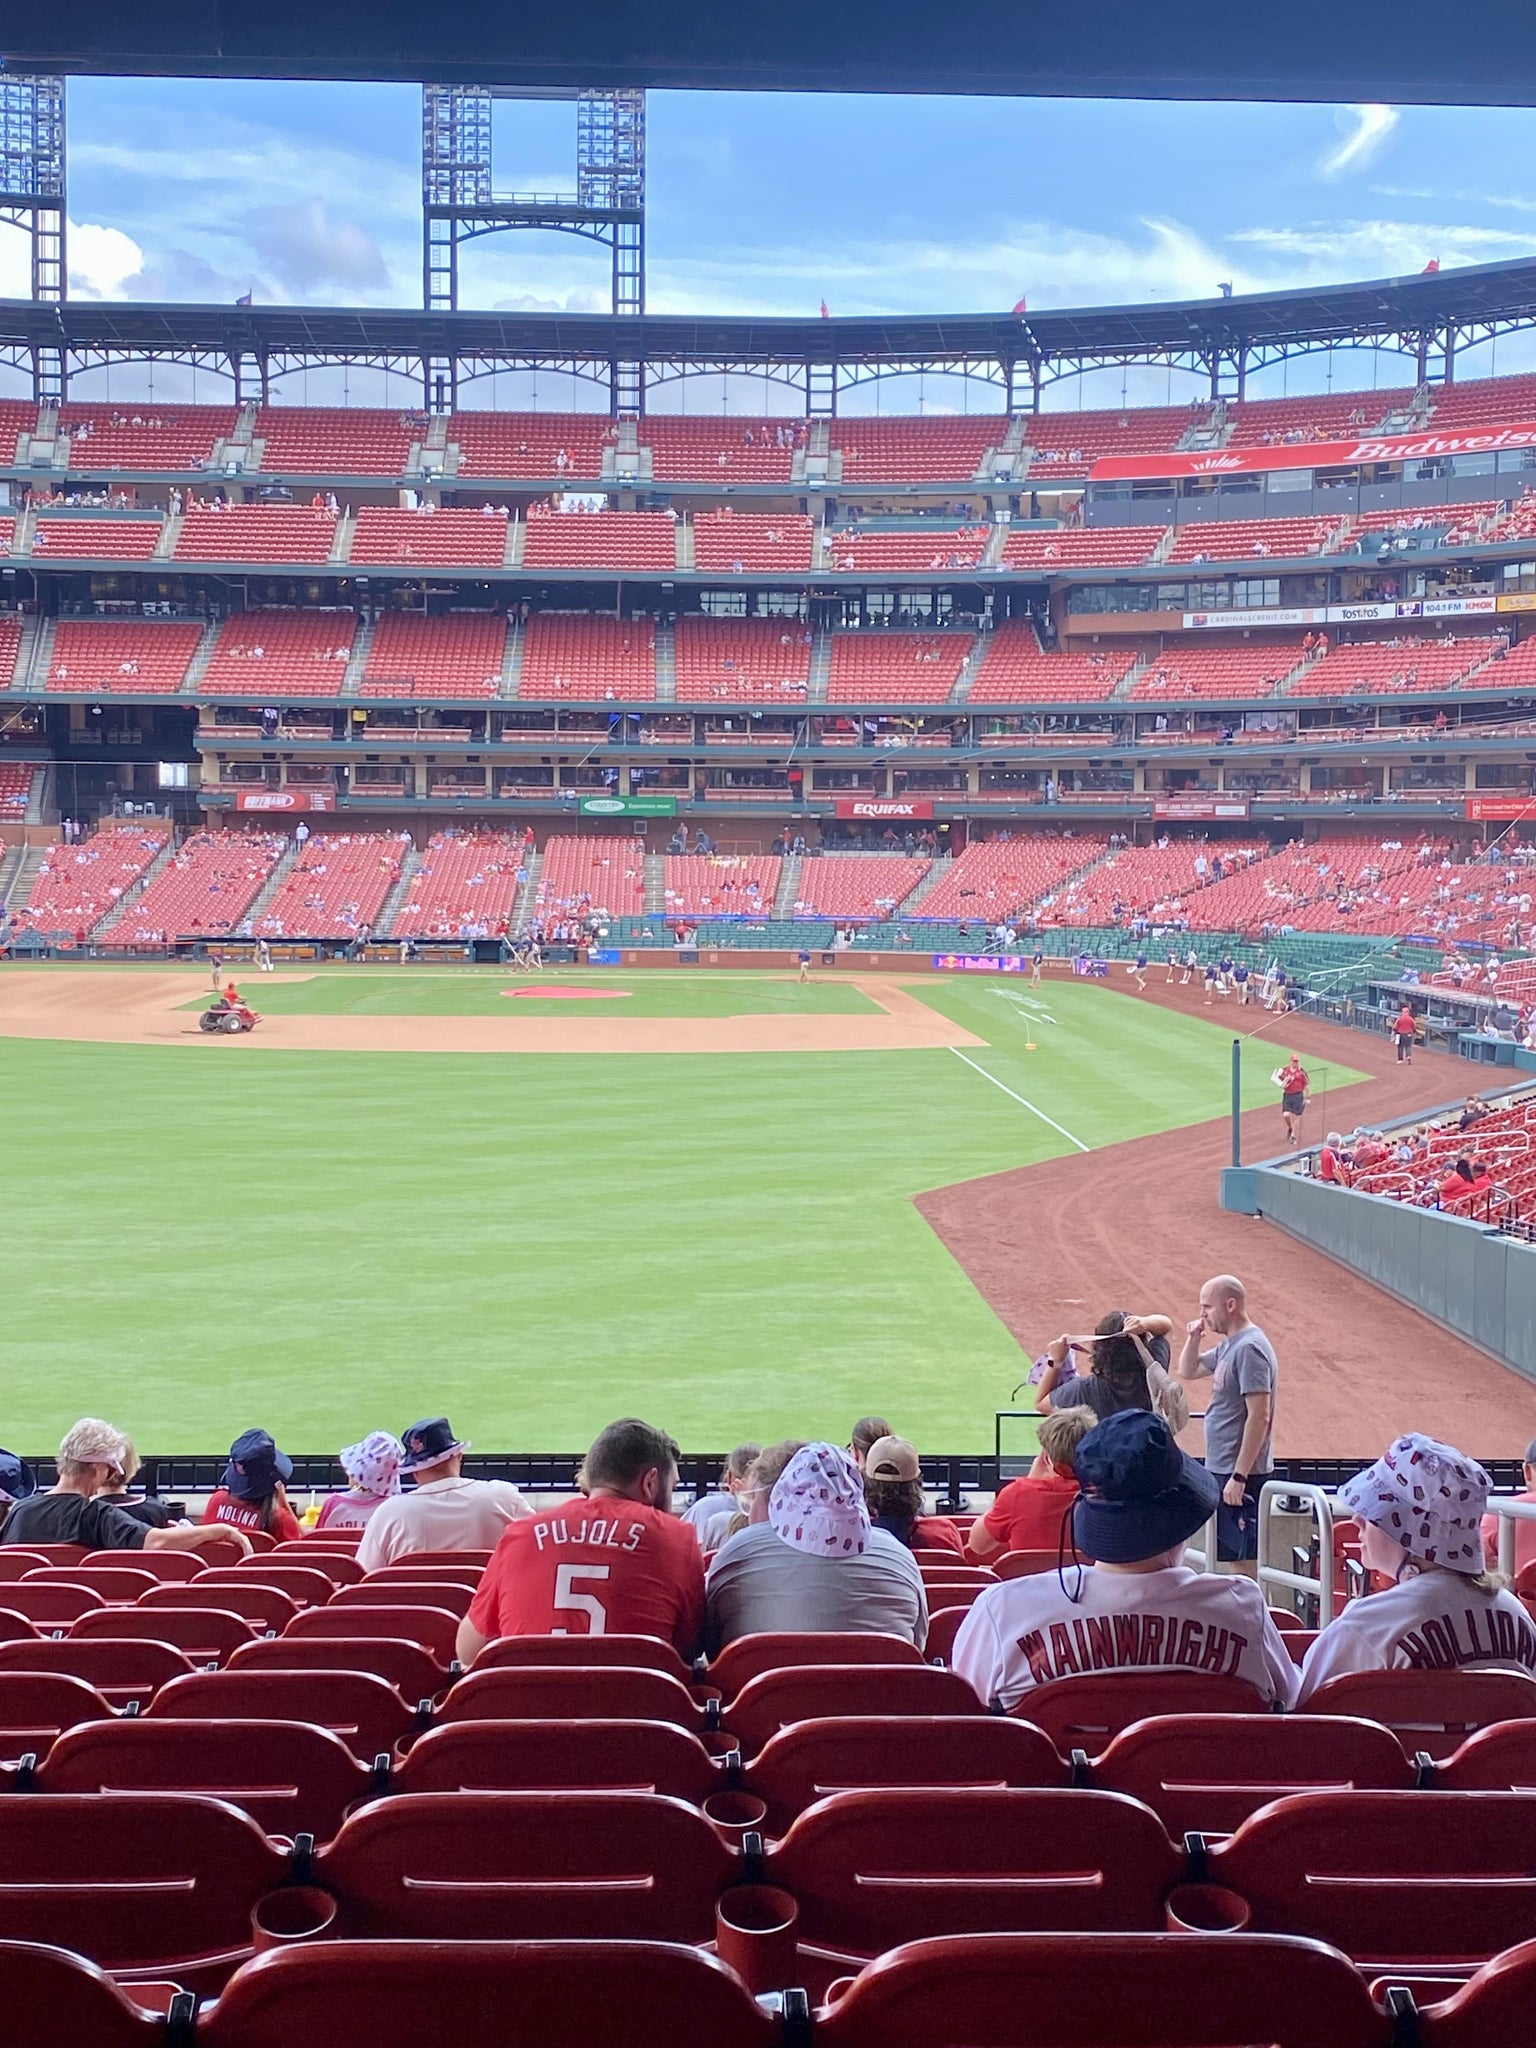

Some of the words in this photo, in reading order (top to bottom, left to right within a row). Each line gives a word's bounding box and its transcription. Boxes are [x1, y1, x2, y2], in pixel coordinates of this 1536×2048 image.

[1343, 429, 1536, 460] Budweis
[1342, 607, 1379, 619] TOSTITOS
[1448, 603, 1461, 611] FM
[1465, 600, 1493, 610] KMOX
[853, 803, 915, 817] EQUIFAX
[216, 1505, 258, 1528] MOLINA
[533, 1519, 646, 1551] PUJOLS
[552, 1564, 610, 1635] 5
[1016, 1614, 1248, 1684] WAINWRIGHT
[1397, 1608, 1536, 1670] HOLLIDA
